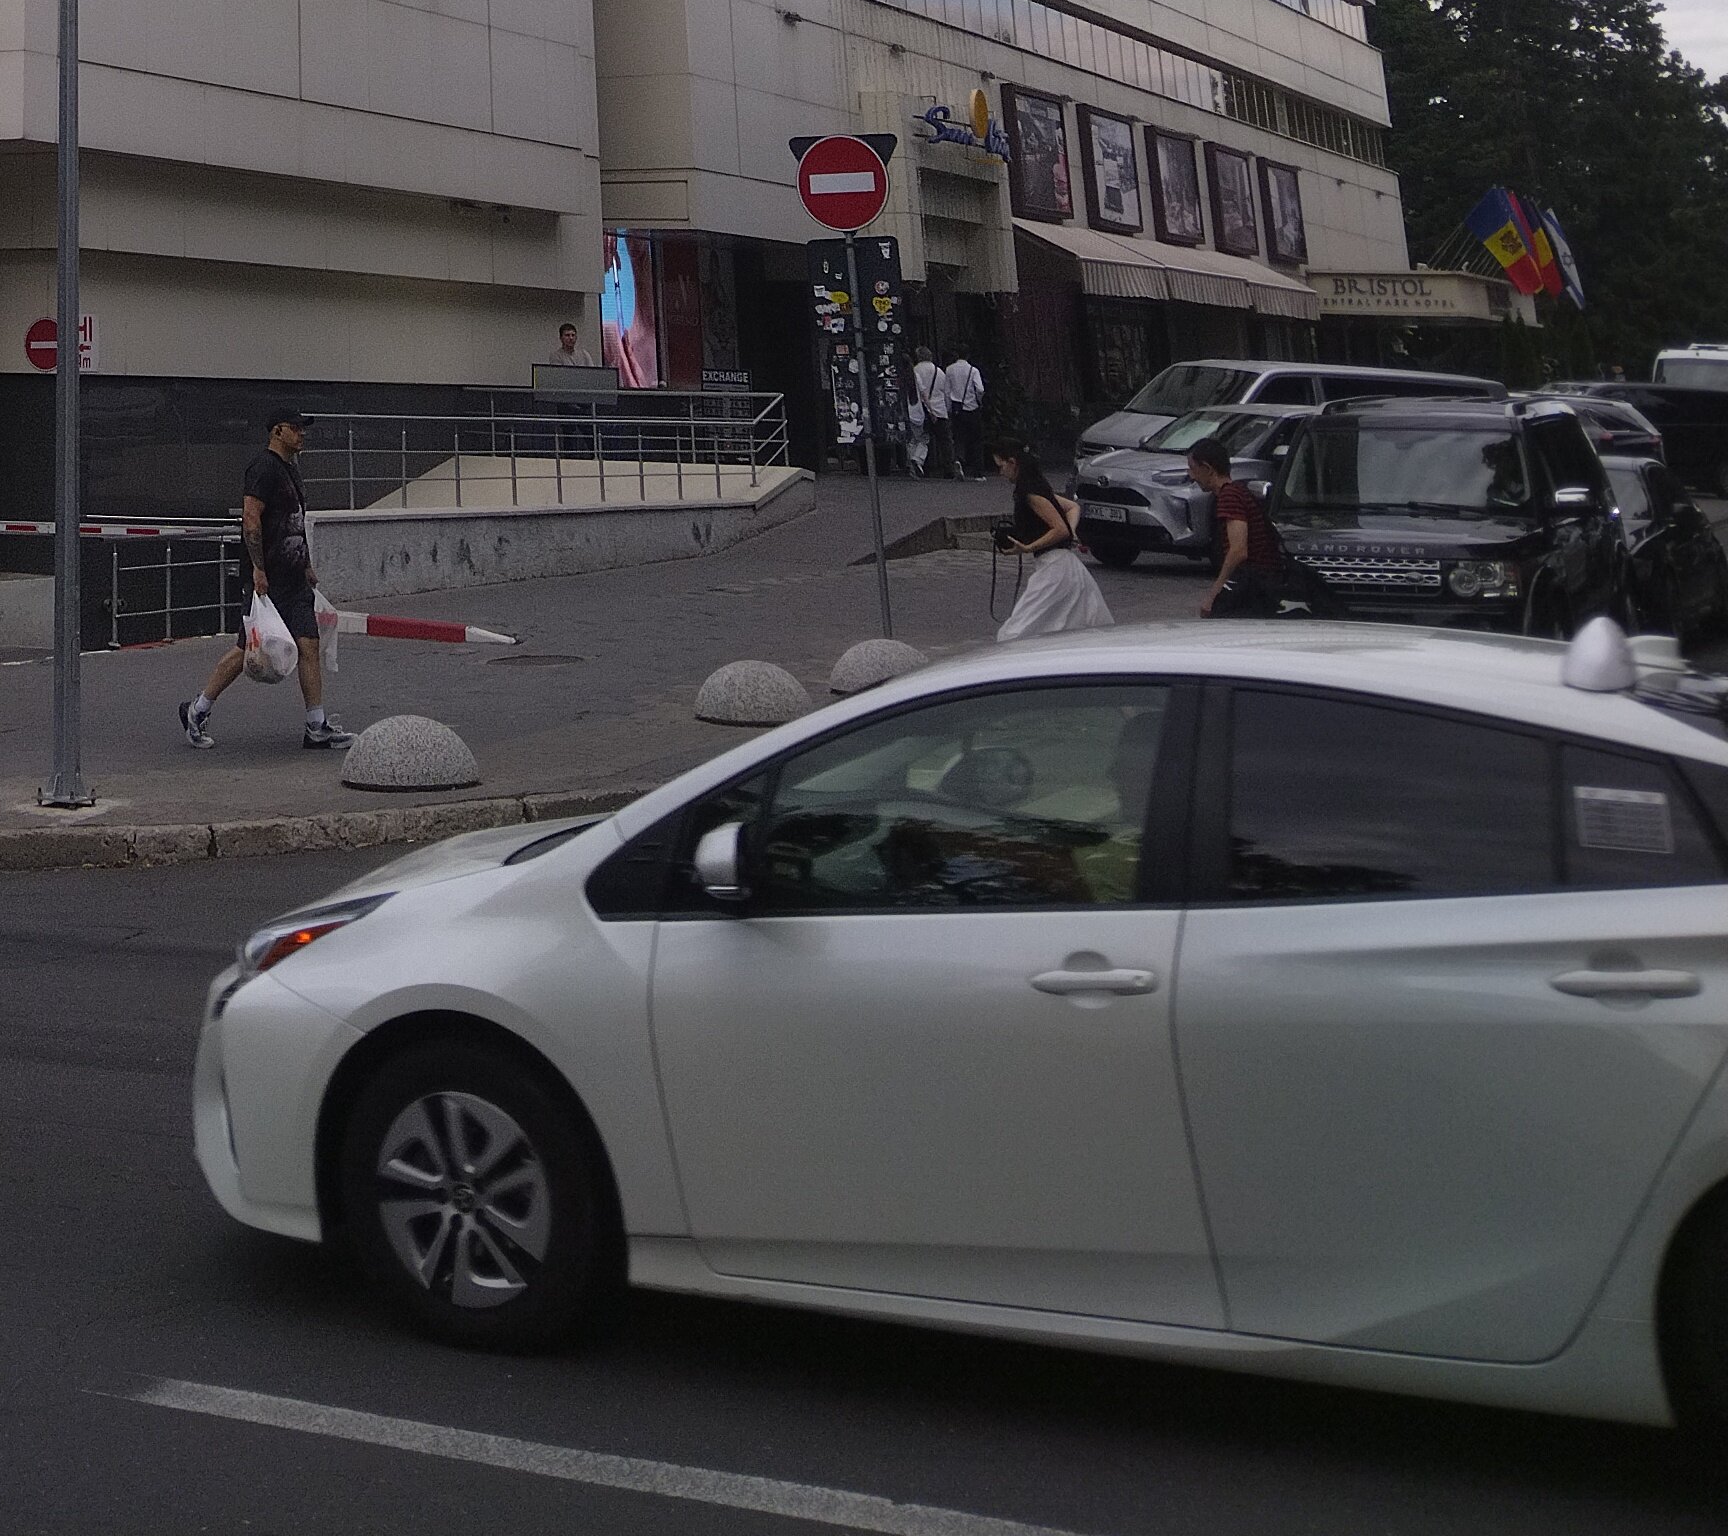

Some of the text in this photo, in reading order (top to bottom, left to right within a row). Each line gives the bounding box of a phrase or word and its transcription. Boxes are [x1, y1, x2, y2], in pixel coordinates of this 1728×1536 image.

[1333, 278, 1432, 297] BRISTOL
[702, 370, 749, 383] EXCHANGE
[1297, 543, 1426, 555] LAND ROVER
